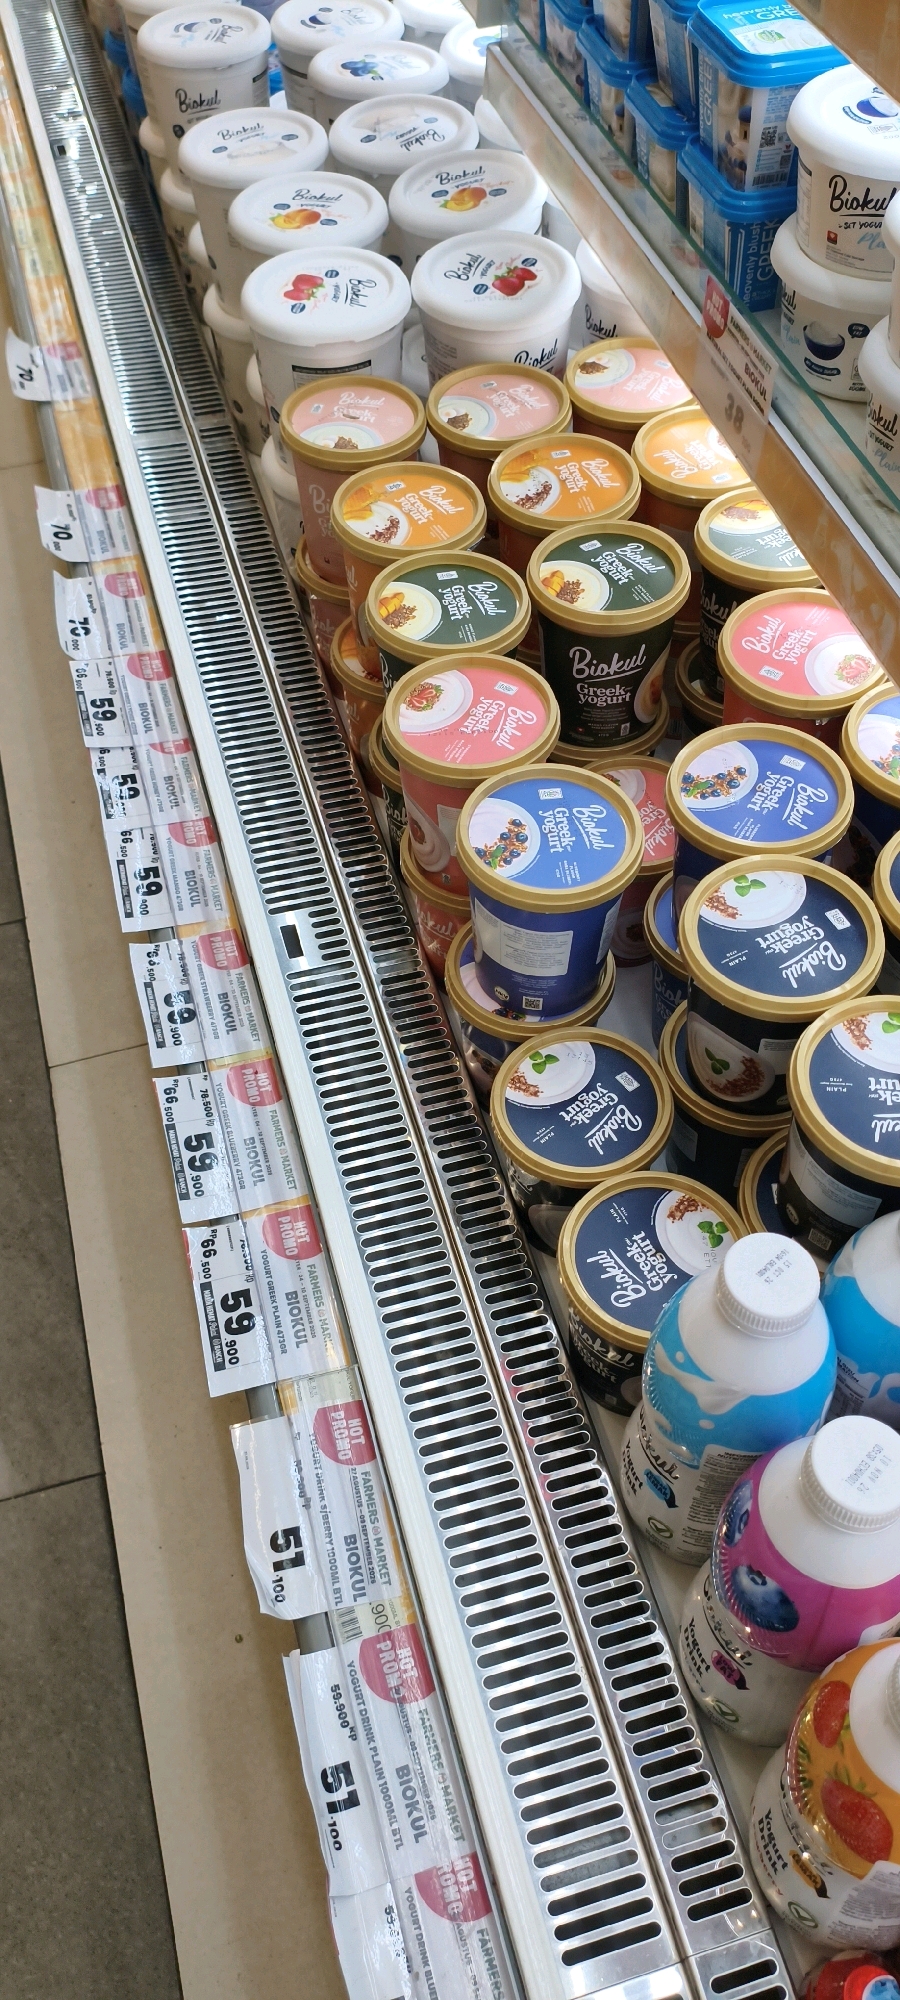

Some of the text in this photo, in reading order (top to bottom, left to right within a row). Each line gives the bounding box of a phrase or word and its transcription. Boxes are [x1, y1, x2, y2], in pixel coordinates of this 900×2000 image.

[555, 464, 580, 494] yogurt
[567, 462, 588, 488] Greek
[581, 458, 620, 488] Biokul
[394, 498, 428, 525] yogurt
[406, 493, 432, 519] Greek
[419, 486, 465, 514] Biokul
[590, 558, 630, 586] yogurt
[602, 551, 633, 578] Greek
[616, 542, 666, 574] Biokul
[438, 588, 463, 621] yogurt
[452, 585, 472, 615] Greek
[468, 582, 506, 616] Biokul
[742, 615, 782, 654] Biokul
[772, 628, 802, 660] Greek
[784, 630, 817, 665] yogurt
[569, 644, 647, 679] Biokul
[576, 683, 626, 697] Greek
[578, 692, 632, 707] yogurt
[138, 702, 154, 734] BIOKUL
[459, 696, 490, 734] yogurt
[477, 700, 506, 734] Greek
[496, 706, 537, 750] Biokul
[164, 776, 180, 810] BIOKUL
[747, 771, 780, 812] yogurt
[768, 775, 795, 809] Greek
[787, 782, 829, 831] Biokul
[539, 810, 564, 854] yogurt
[554, 807, 576, 848] Greek
[573, 804, 615, 850] Biokul
[184, 870, 200, 908] BIOKUL
[224, 940, 238, 957] HOT
[755, 915, 815, 949] yogurt
[774, 926, 825, 955] Greek
[210, 936, 227, 967] PROMO
[729, 956, 747, 967] PLAIN
[782, 940, 847, 988] Biokul
[200, 981, 215, 1021] STRAWBERRY
[218, 992, 238, 1036] BIOKUL
[235, 972, 260, 1042] FARMERS MARKET
[241, 1068, 260, 1103] PROMO
[256, 1072, 272, 1092] HOT
[559, 1082, 608, 1122] yogurt
[574, 1091, 619, 1126] Greek
[540, 1132, 555, 1144] PLAIN
[588, 1104, 643, 1155] Biokul
[226, 1131, 240, 1168] BLUEBERRY
[235, 1168, 246, 1190] 473GR
[243, 1136, 266, 1187] BIOKUL
[269, 1109, 298, 1190] FARMERS MARKET
[278, 1216, 298, 1256] PROMO
[294, 1220, 310, 1244] HOT
[626, 1241, 664, 1292] Greek
[631, 1230, 678, 1284] yogurt
[306, 1264, 324, 1308] FARMERS
[586, 1250, 647, 1308] Biokul
[260, 1249, 288, 1354] YOGURT GREEK PLAIN 473GR
[284, 1290, 309, 1348] BIOKUL
[206, 1304, 214, 1320] HEMAT
[214, 1343, 222, 1363] RANCH
[331, 1410, 352, 1460] PROMO
[348, 1418, 365, 1445] HOT
[320, 1504, 333, 1542] S/BERRY
[361, 1470, 392, 1586] FARMERS MARKET
[326, 1542, 340, 1587] 1000ML
[343, 1534, 367, 1602] BIOKUL
[360, 1525, 374, 1564] SEPTEMBER
[367, 1565, 376, 1584] 2026
[332, 1588, 344, 1607] BTL
[398, 1646, 418, 1679] HOT
[331, 1684, 349, 1728] 59.900
[347, 1660, 404, 1850] YOGURT DRINK PLAIN 1000ML BTL
[417, 1708, 466, 1843] FARMERS MARKET
[396, 1764, 427, 1844] BIOKUL
[424, 1800, 436, 1821] 2026
[404, 1886, 432, 1968] YOGURT DRINK
